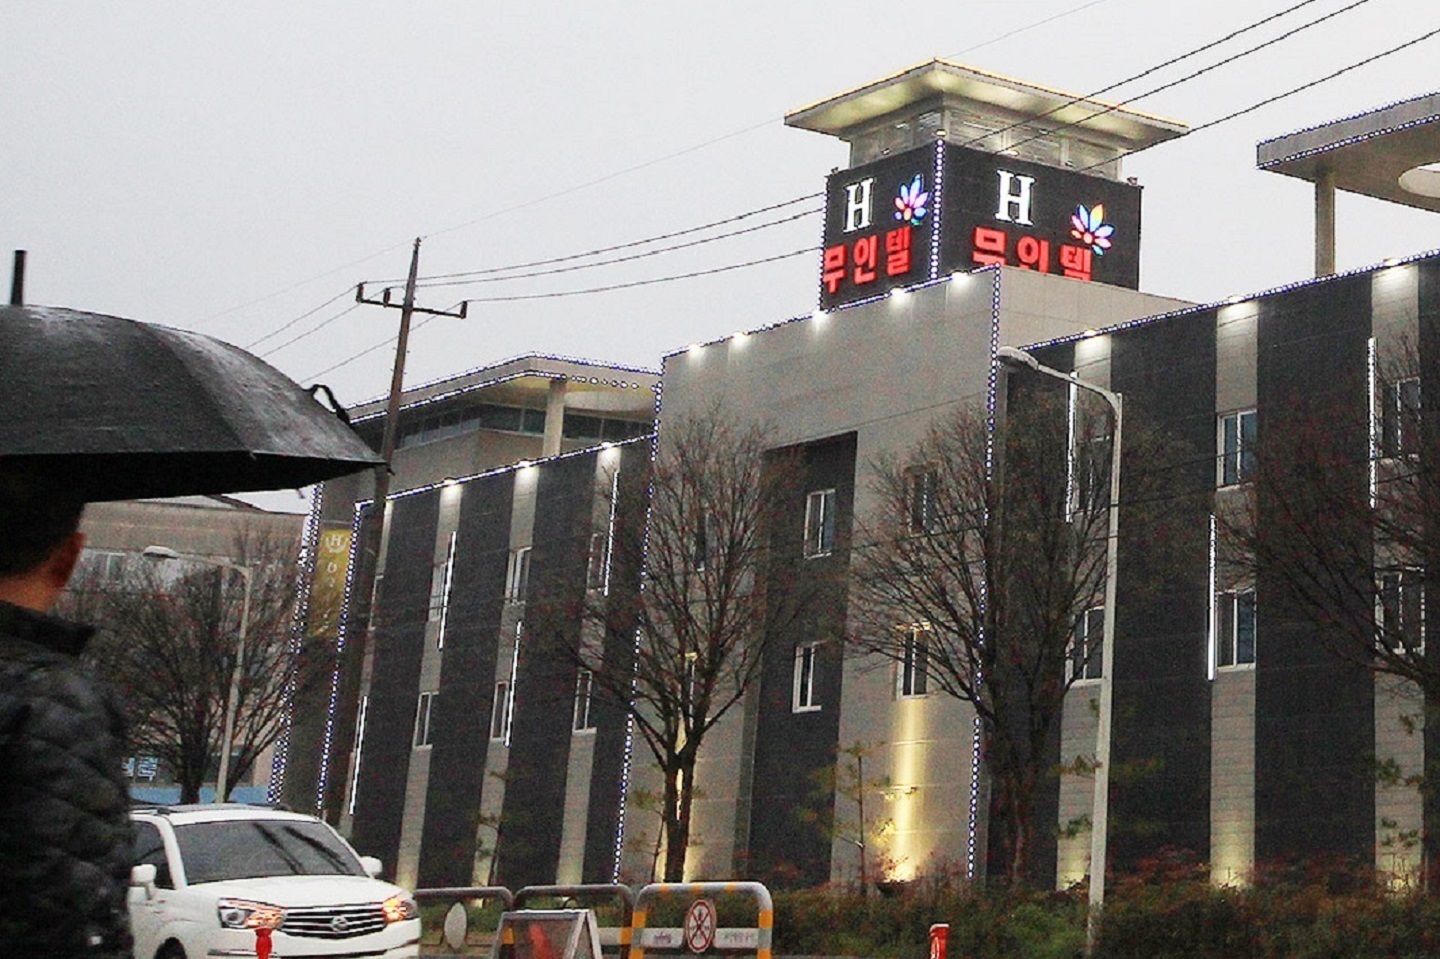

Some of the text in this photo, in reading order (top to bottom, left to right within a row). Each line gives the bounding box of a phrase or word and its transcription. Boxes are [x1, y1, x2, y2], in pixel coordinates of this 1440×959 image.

[843, 177, 874, 233] H
[995, 170, 1037, 226] H
[822, 226, 913, 295] 무인텔
